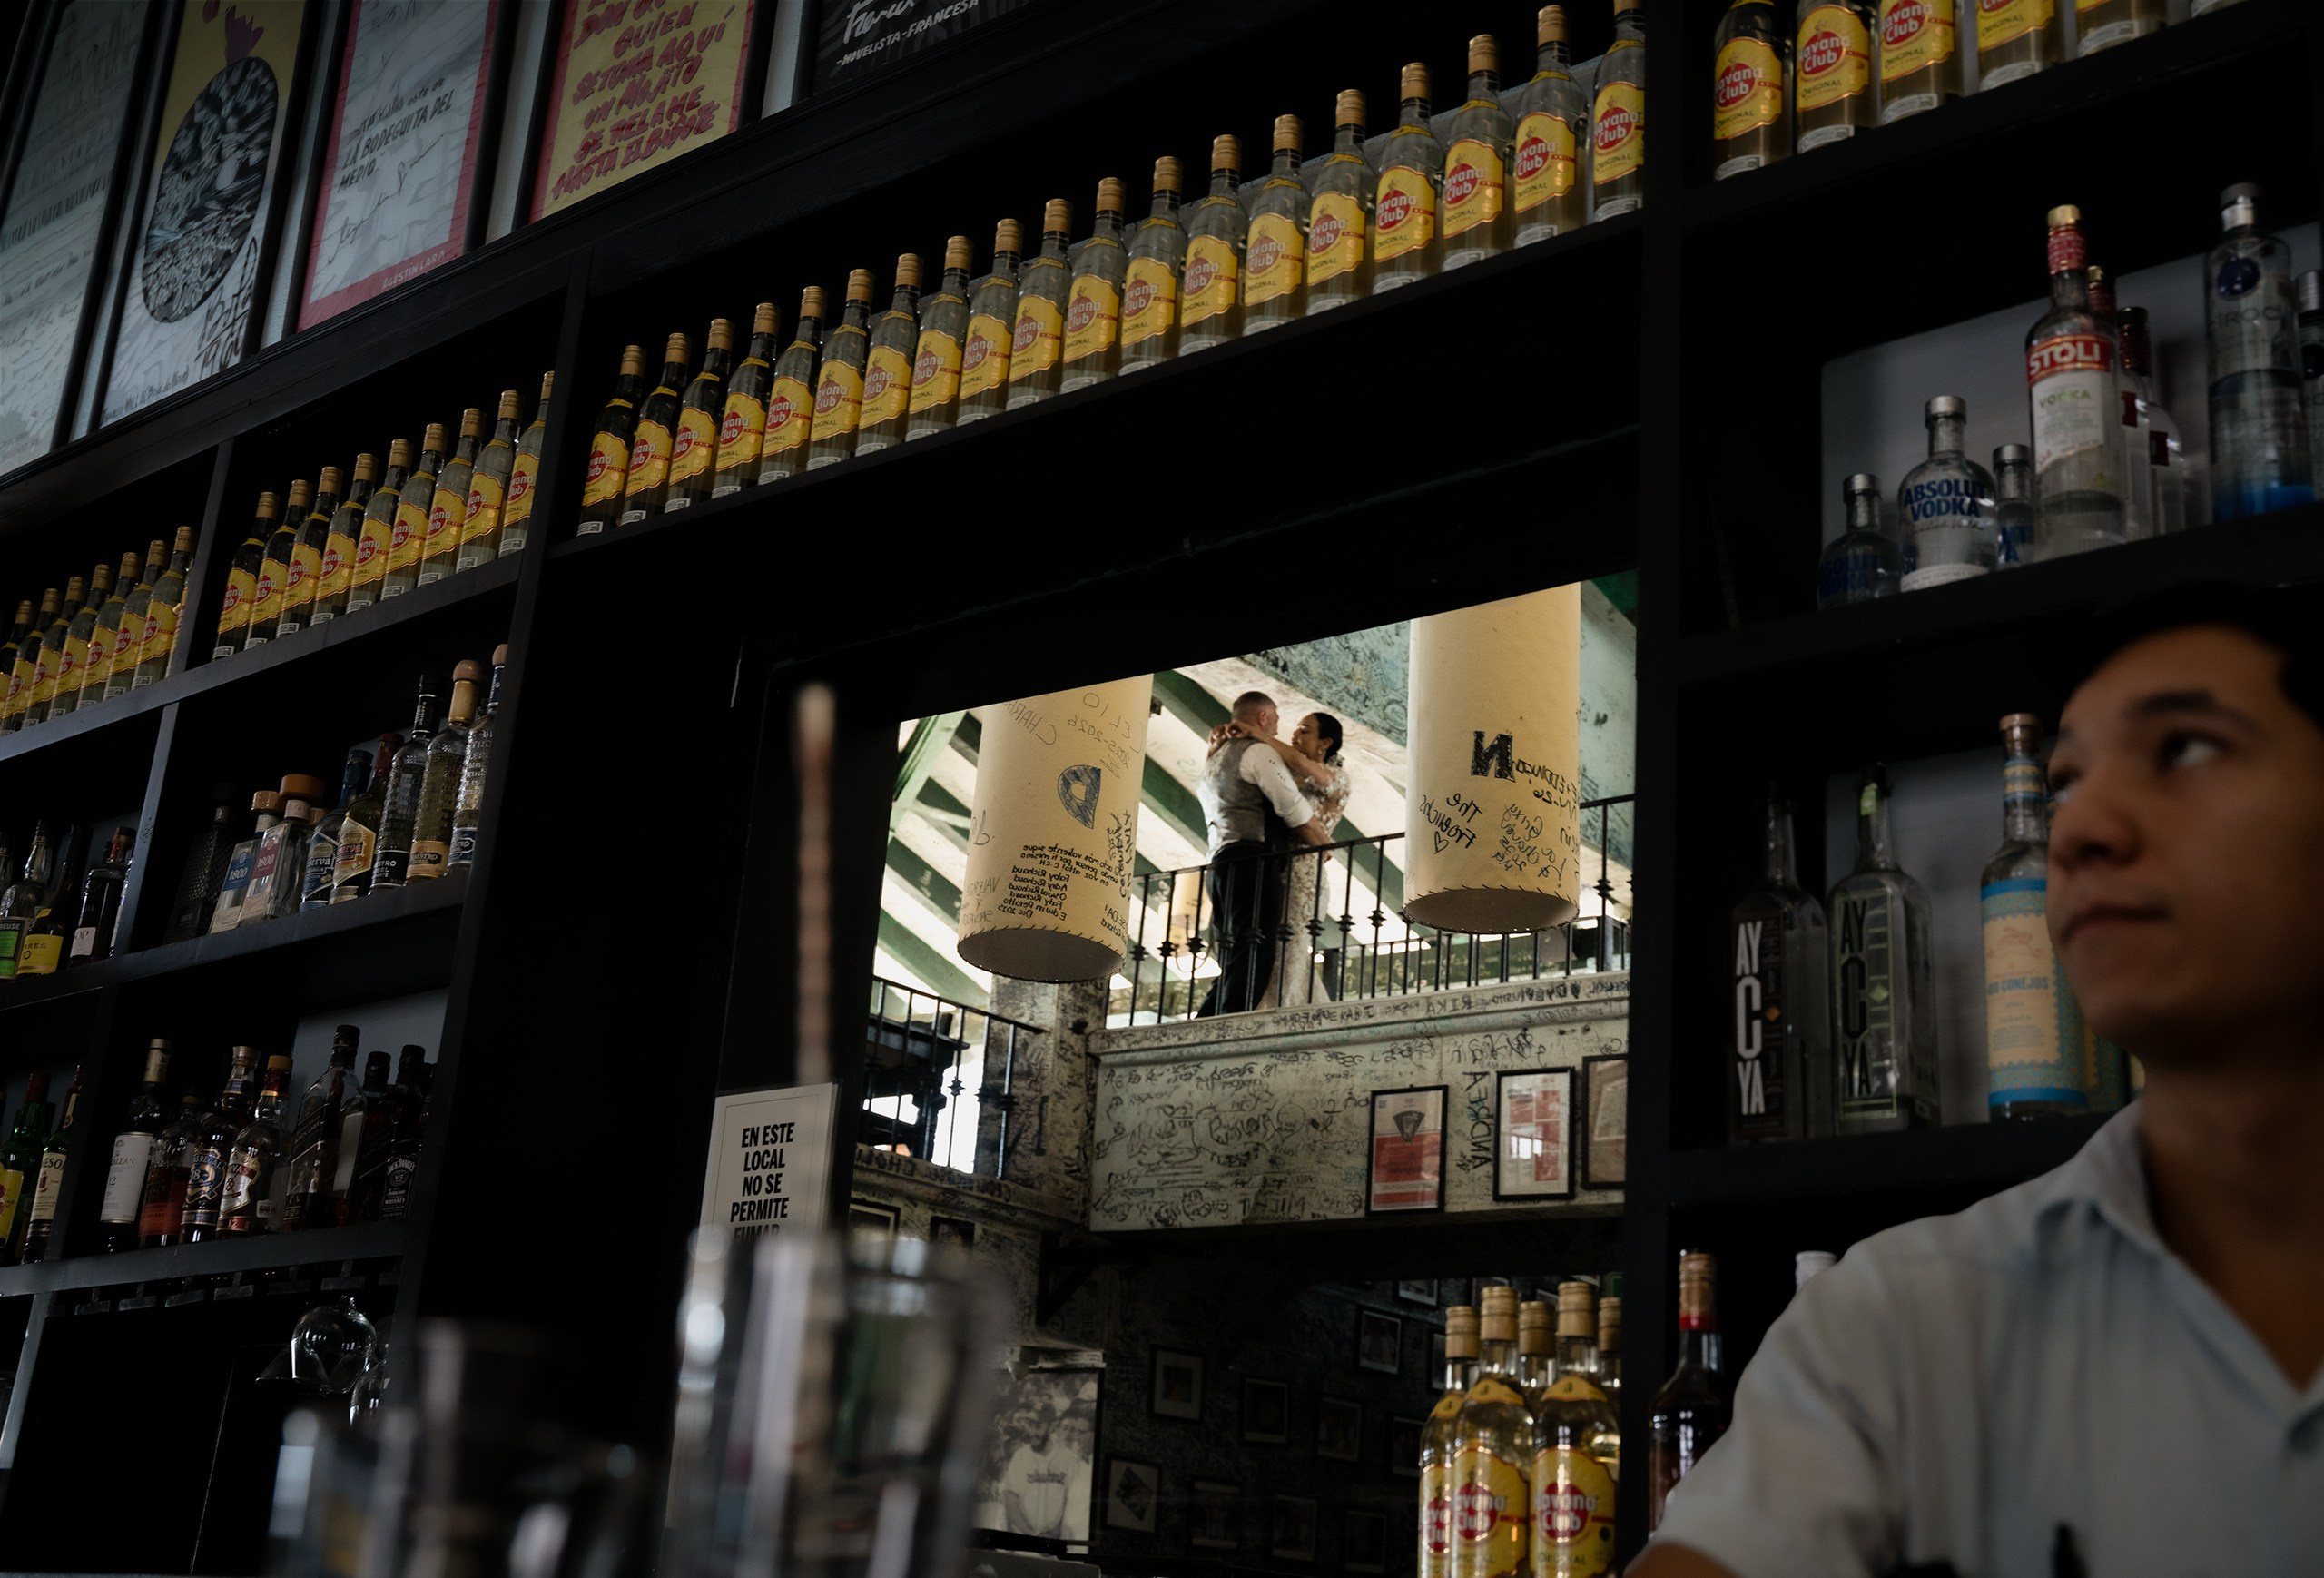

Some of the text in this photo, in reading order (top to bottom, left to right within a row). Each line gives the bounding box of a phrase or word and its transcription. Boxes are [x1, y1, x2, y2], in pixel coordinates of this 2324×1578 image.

[1885, 18, 1920, 44] Club
[1803, 51, 1838, 74] Club
[360, 102, 428, 160] BODEGUITA
[428, 89, 455, 122] DEL
[2027, 340, 2101, 375] STOLI
[1904, 478, 1987, 508] ABSOLUT
[1909, 498, 1980, 522] VODKA
[257, 853, 275, 868] 1800
[229, 867, 249, 881] 1800
[742, 1122, 795, 1148] EN ESTE
[743, 1148, 785, 1172] LOCAL
[742, 1173, 783, 1197] NO SE
[730, 1197, 790, 1223] PERMITE
